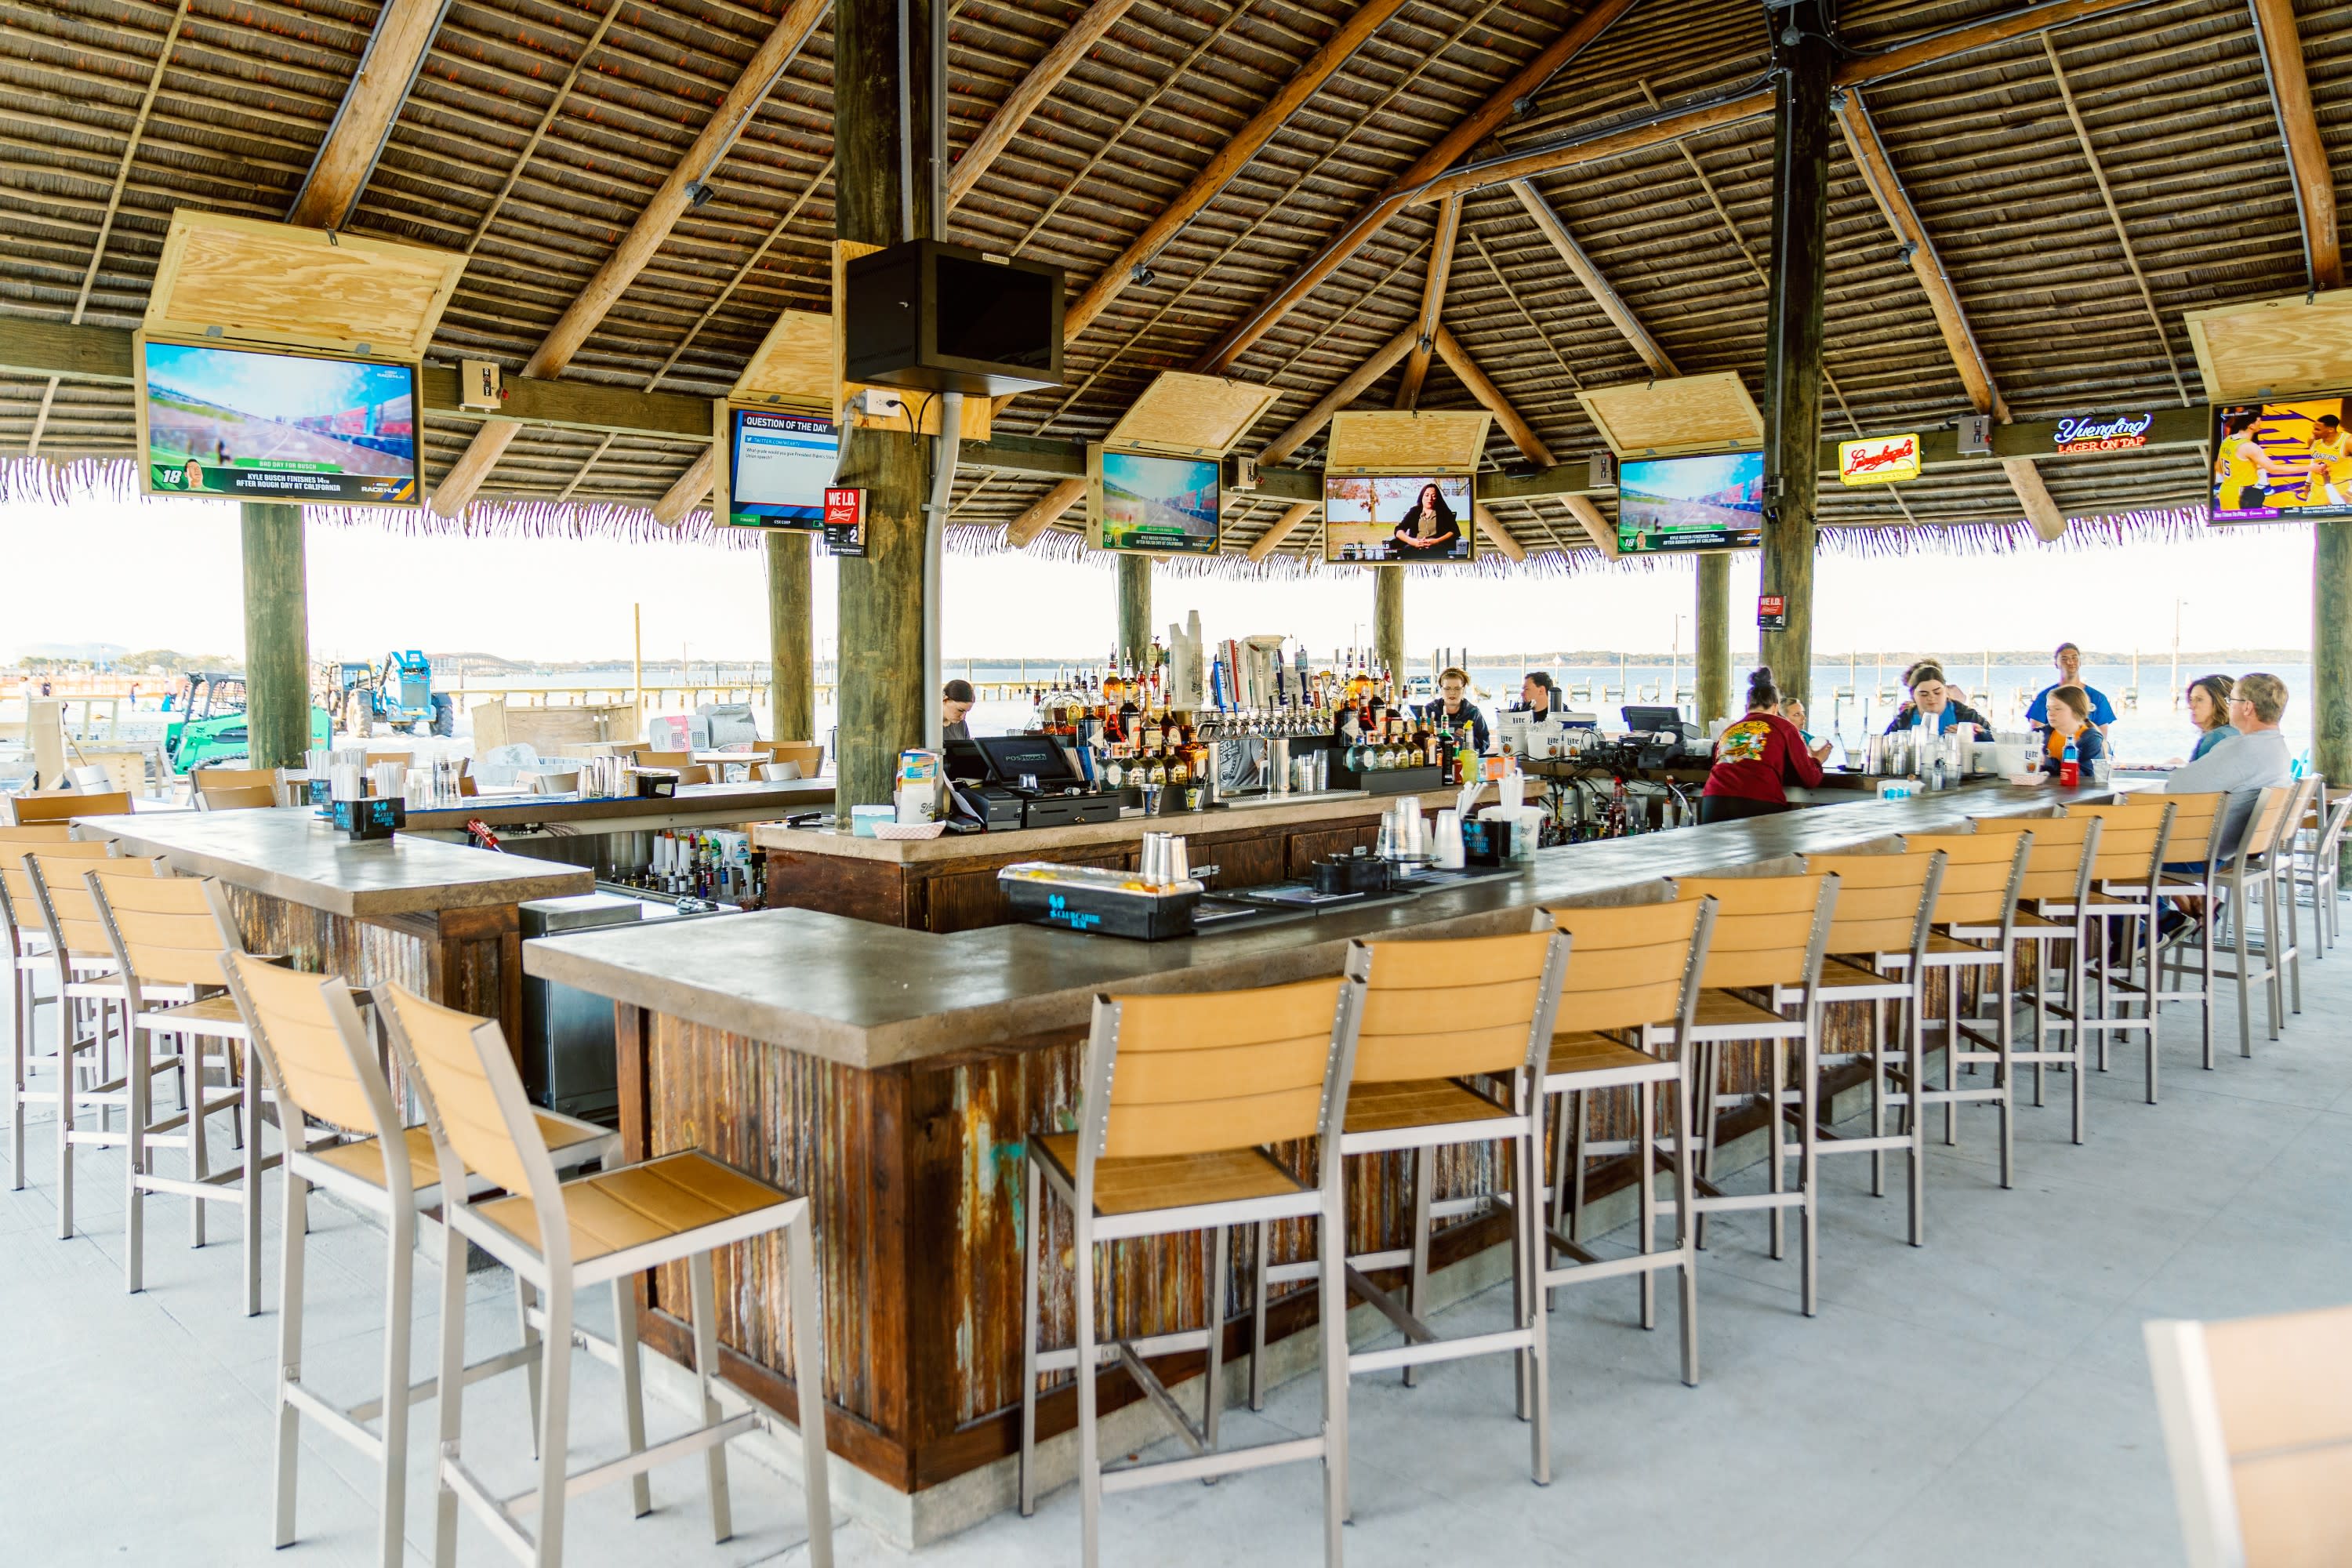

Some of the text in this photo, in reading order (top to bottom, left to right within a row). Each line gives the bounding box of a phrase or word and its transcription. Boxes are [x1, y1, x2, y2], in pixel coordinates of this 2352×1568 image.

[746, 416, 828, 433] QUESTION OF THE DAY
[2053, 413, 2151, 444] Yuengling
[2057, 436, 2147, 454] LAGER ON TAP
[162, 470, 182, 484] 18
[264, 474, 285, 482] BUSCH
[286, 474, 316, 484] FINISHES
[303, 483, 341, 492] CALIFORNIA
[828, 492, 856, 506] WE I.D.
[849, 528, 858, 543] 2
[1104, 534, 1112, 543] 18
[1624, 539, 1635, 547] 18
[1501, 735, 1512, 744] Lite
[1547, 737, 1559, 746] Lite
[1567, 737, 1580, 746] Lite
[2025, 750, 2038, 760] Lite
[1071, 920, 1087, 929] RUM
